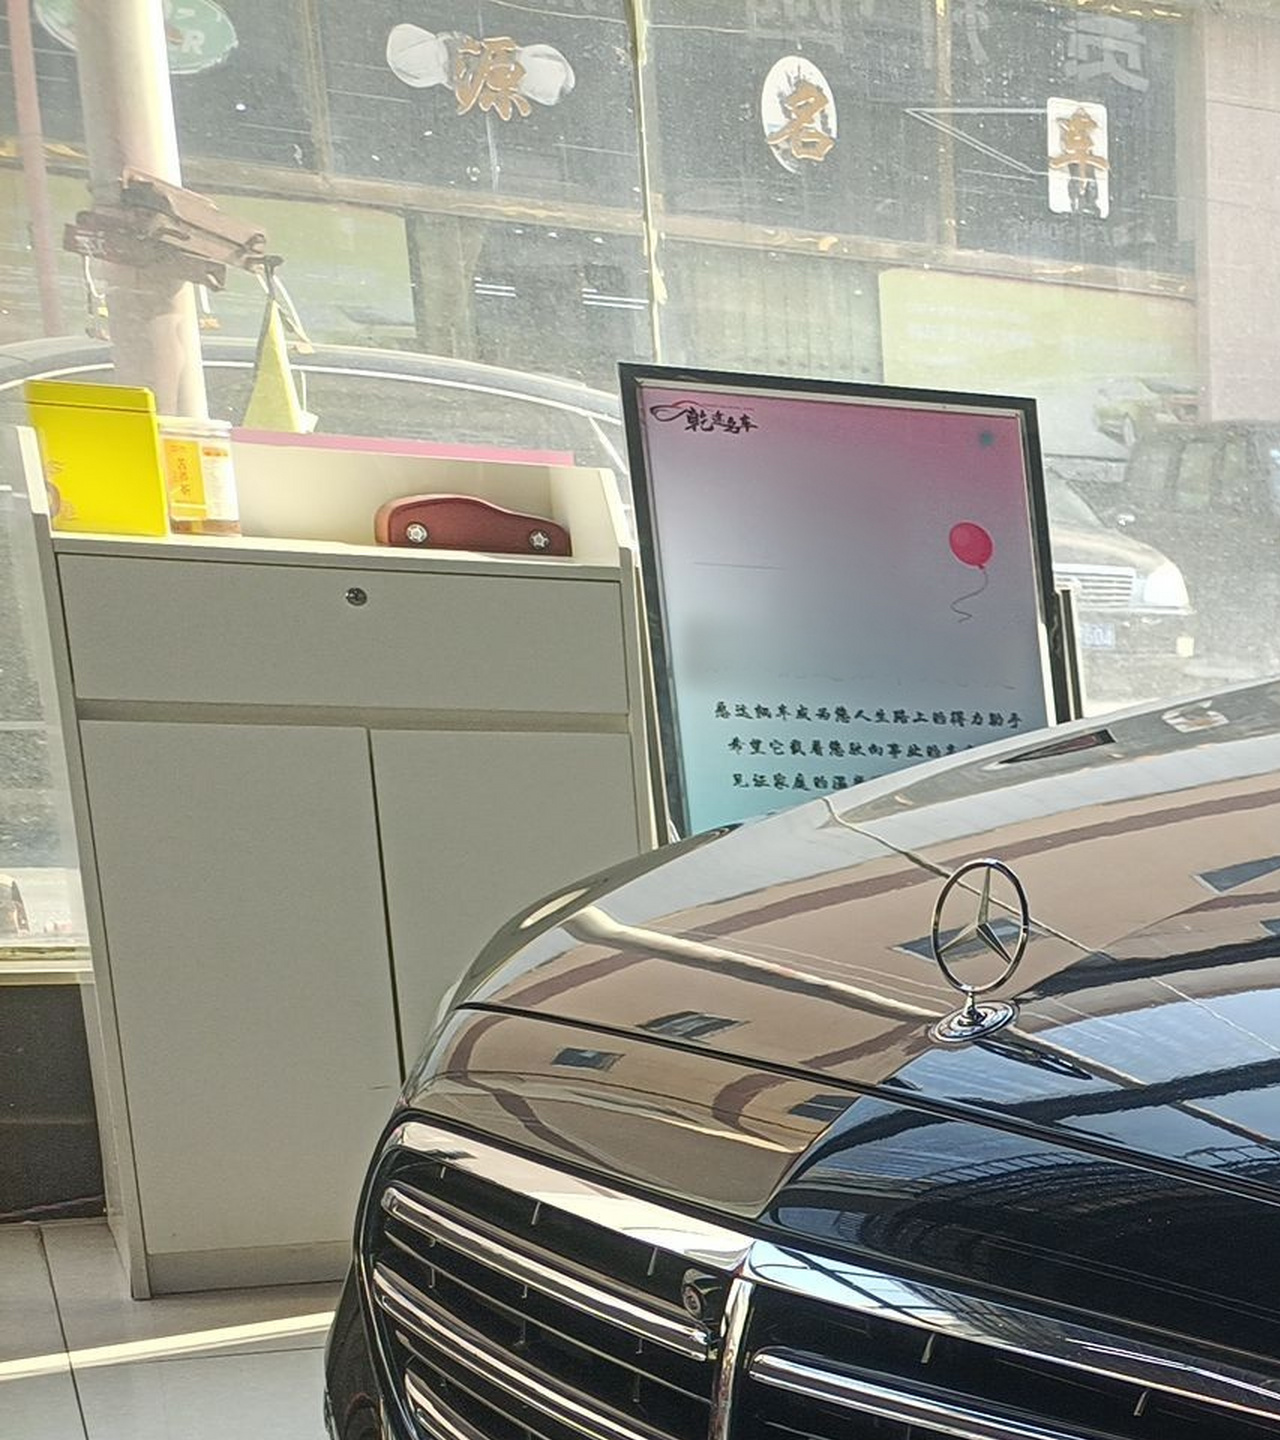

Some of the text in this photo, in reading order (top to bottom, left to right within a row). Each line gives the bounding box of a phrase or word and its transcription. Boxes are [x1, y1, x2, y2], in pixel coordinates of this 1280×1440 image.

[456, 34, 531, 121] 源
[766, 78, 837, 161] 名
[727, 736, 975, 758] 希望它载着您驶向事业的
